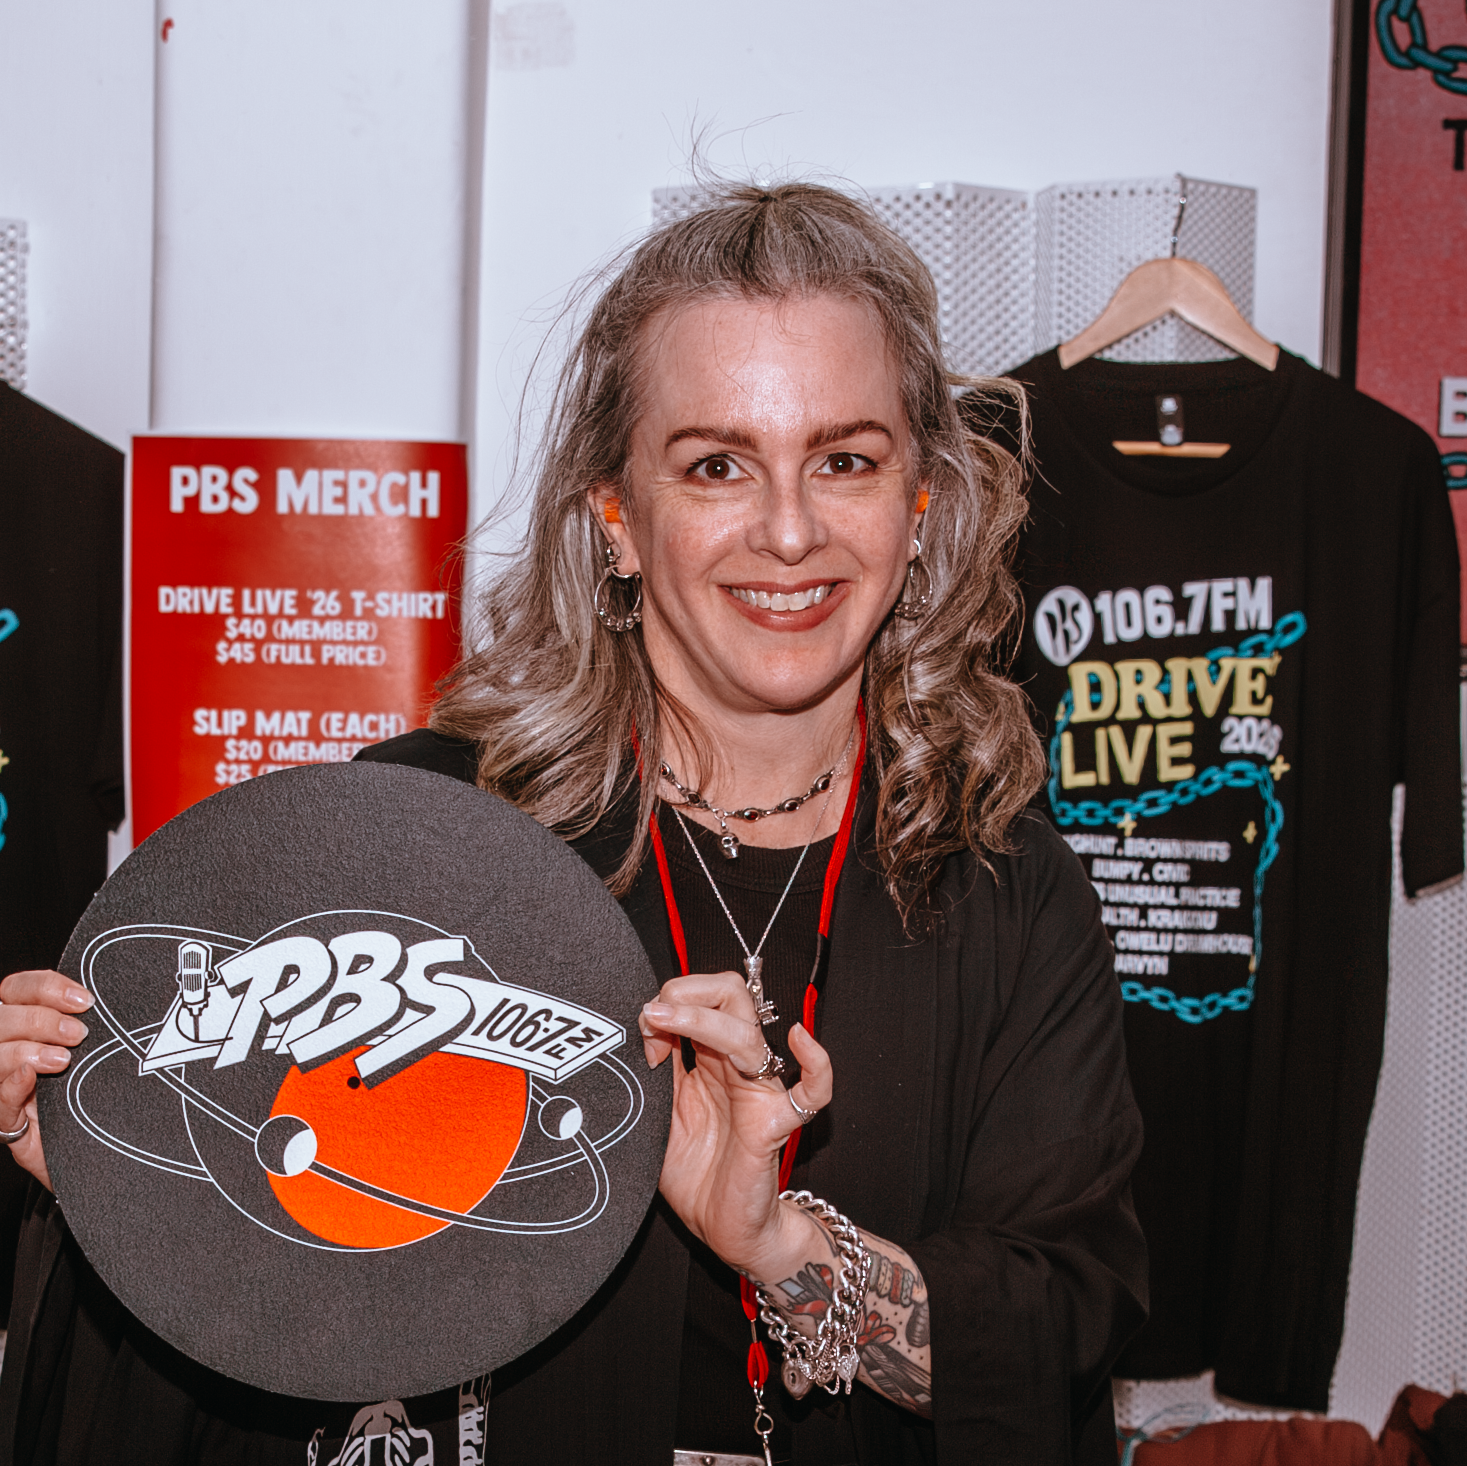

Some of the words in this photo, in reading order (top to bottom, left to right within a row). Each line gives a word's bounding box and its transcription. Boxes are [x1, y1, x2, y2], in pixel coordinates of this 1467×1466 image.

[169, 465, 260, 514] PBS
[275, 467, 441, 518] MERCH
[158, 585, 234, 614] DRIVE
[241, 588, 298, 615] LIVE
[350, 590, 447, 619] T-SHIRT
[1094, 575, 1273, 644] 106.7FM
[225, 617, 267, 640] $40
[271, 619, 378, 641] (MEMBER)
[215, 640, 256, 665] $45
[261, 642, 316, 666] (FULL
[321, 643, 387, 667] PRICE)
[1067, 656, 1277, 725] DRIVE
[193, 707, 248, 737] SLIP
[254, 709, 312, 738] MAT
[319, 711, 407, 740] (EACH)
[224, 739, 264, 762] $20
[1060, 720, 1195, 790] LIVE
[214, 762, 253, 786] $25
[213, 930, 465, 1082] PBS
